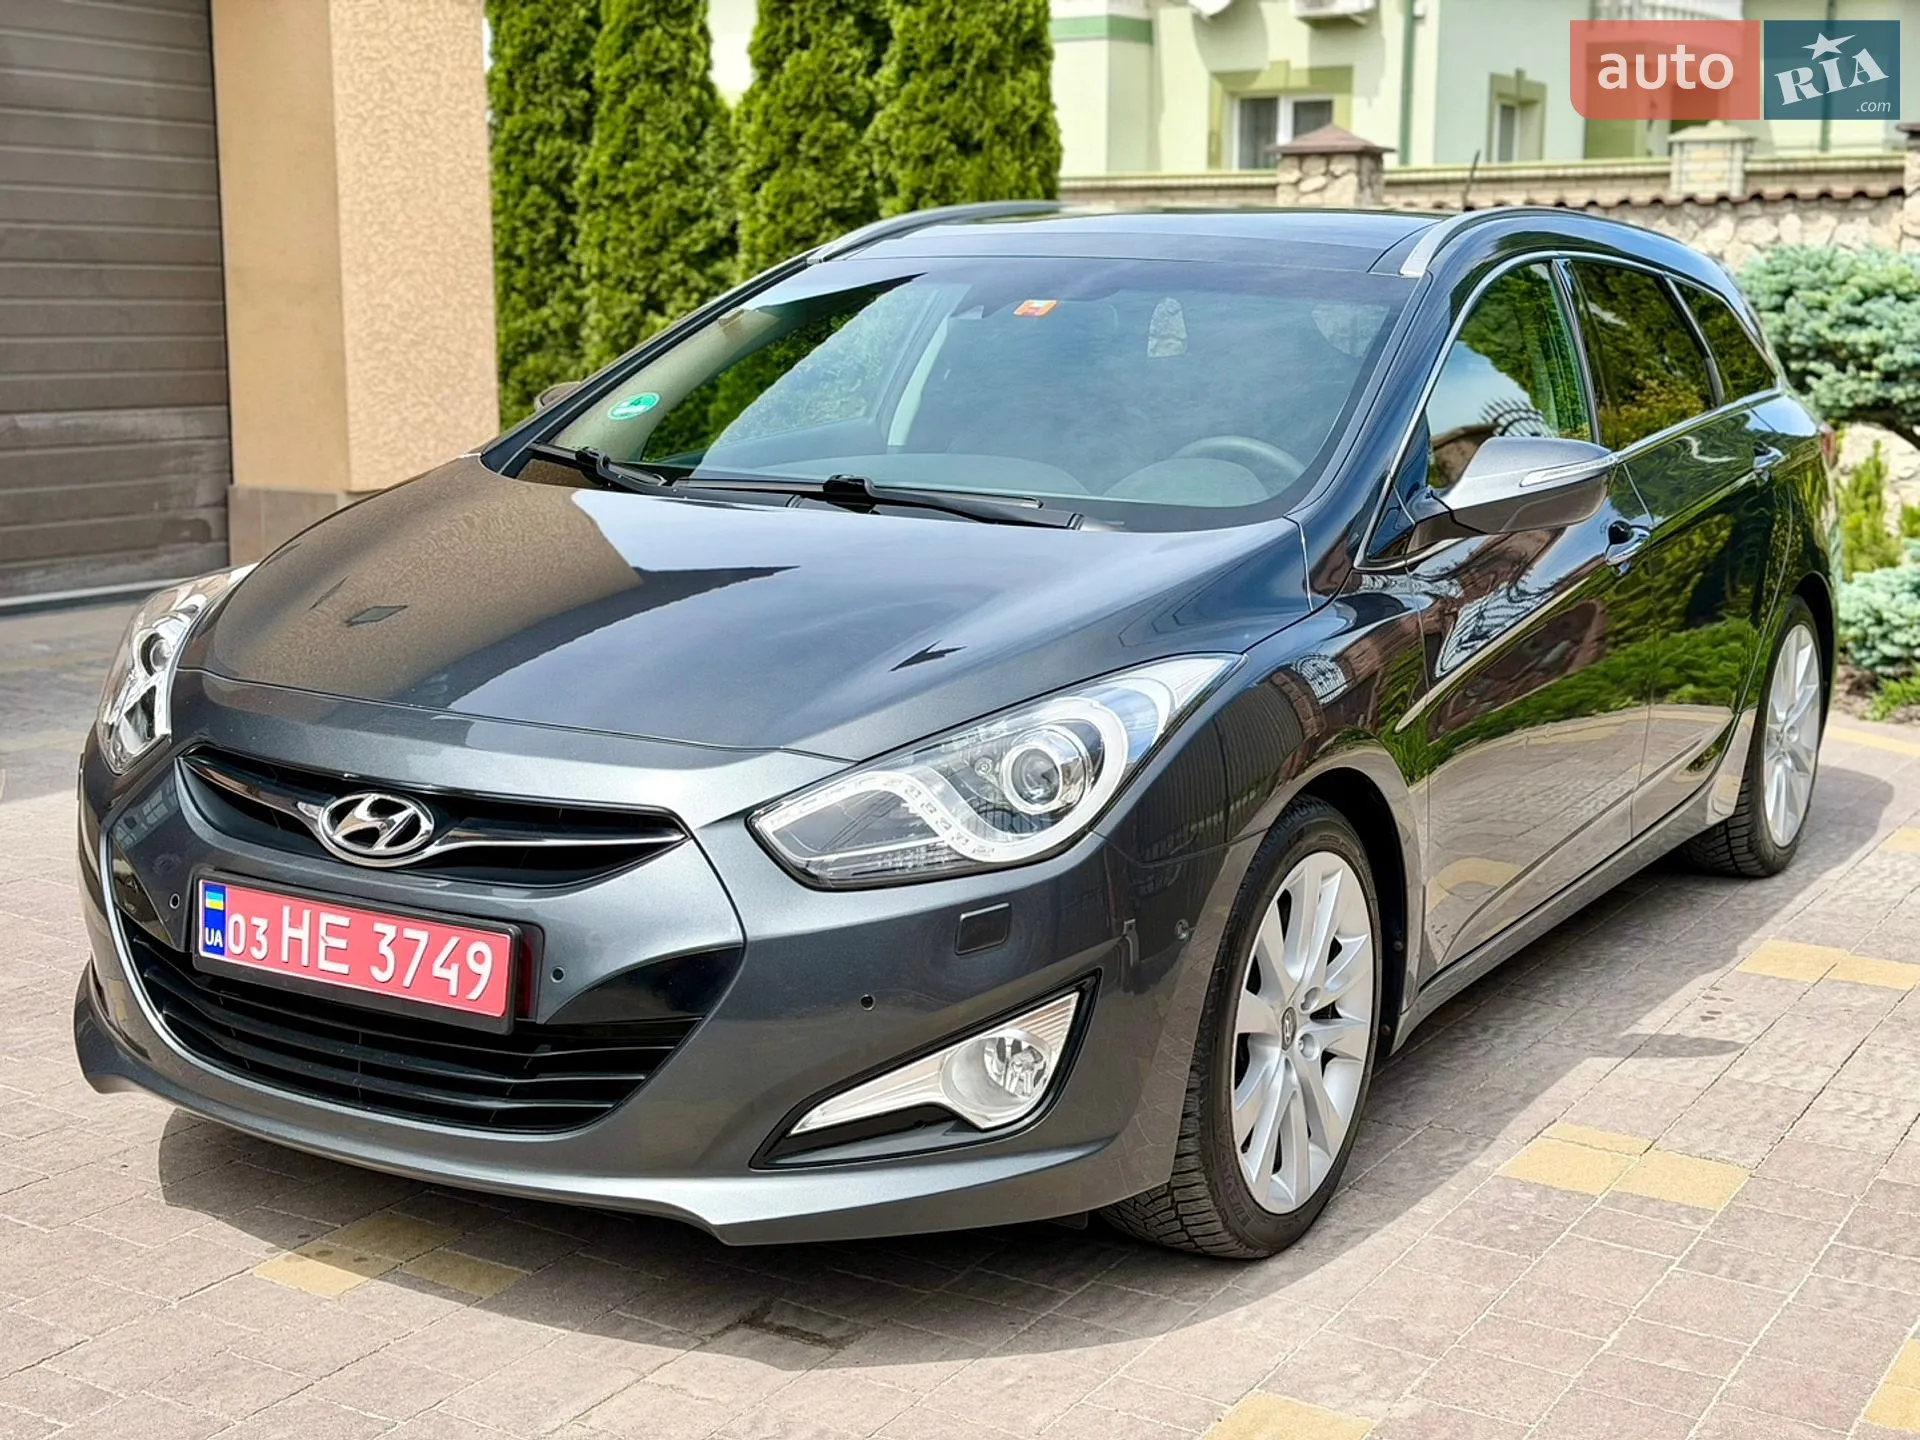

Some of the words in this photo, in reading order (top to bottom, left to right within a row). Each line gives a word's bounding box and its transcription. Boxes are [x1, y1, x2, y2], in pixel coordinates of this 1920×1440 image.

[205, 927, 223, 948] UA
[228, 913, 269, 960] 03
[281, 904, 351, 975] HE
[369, 922, 493, 1001] 3749
